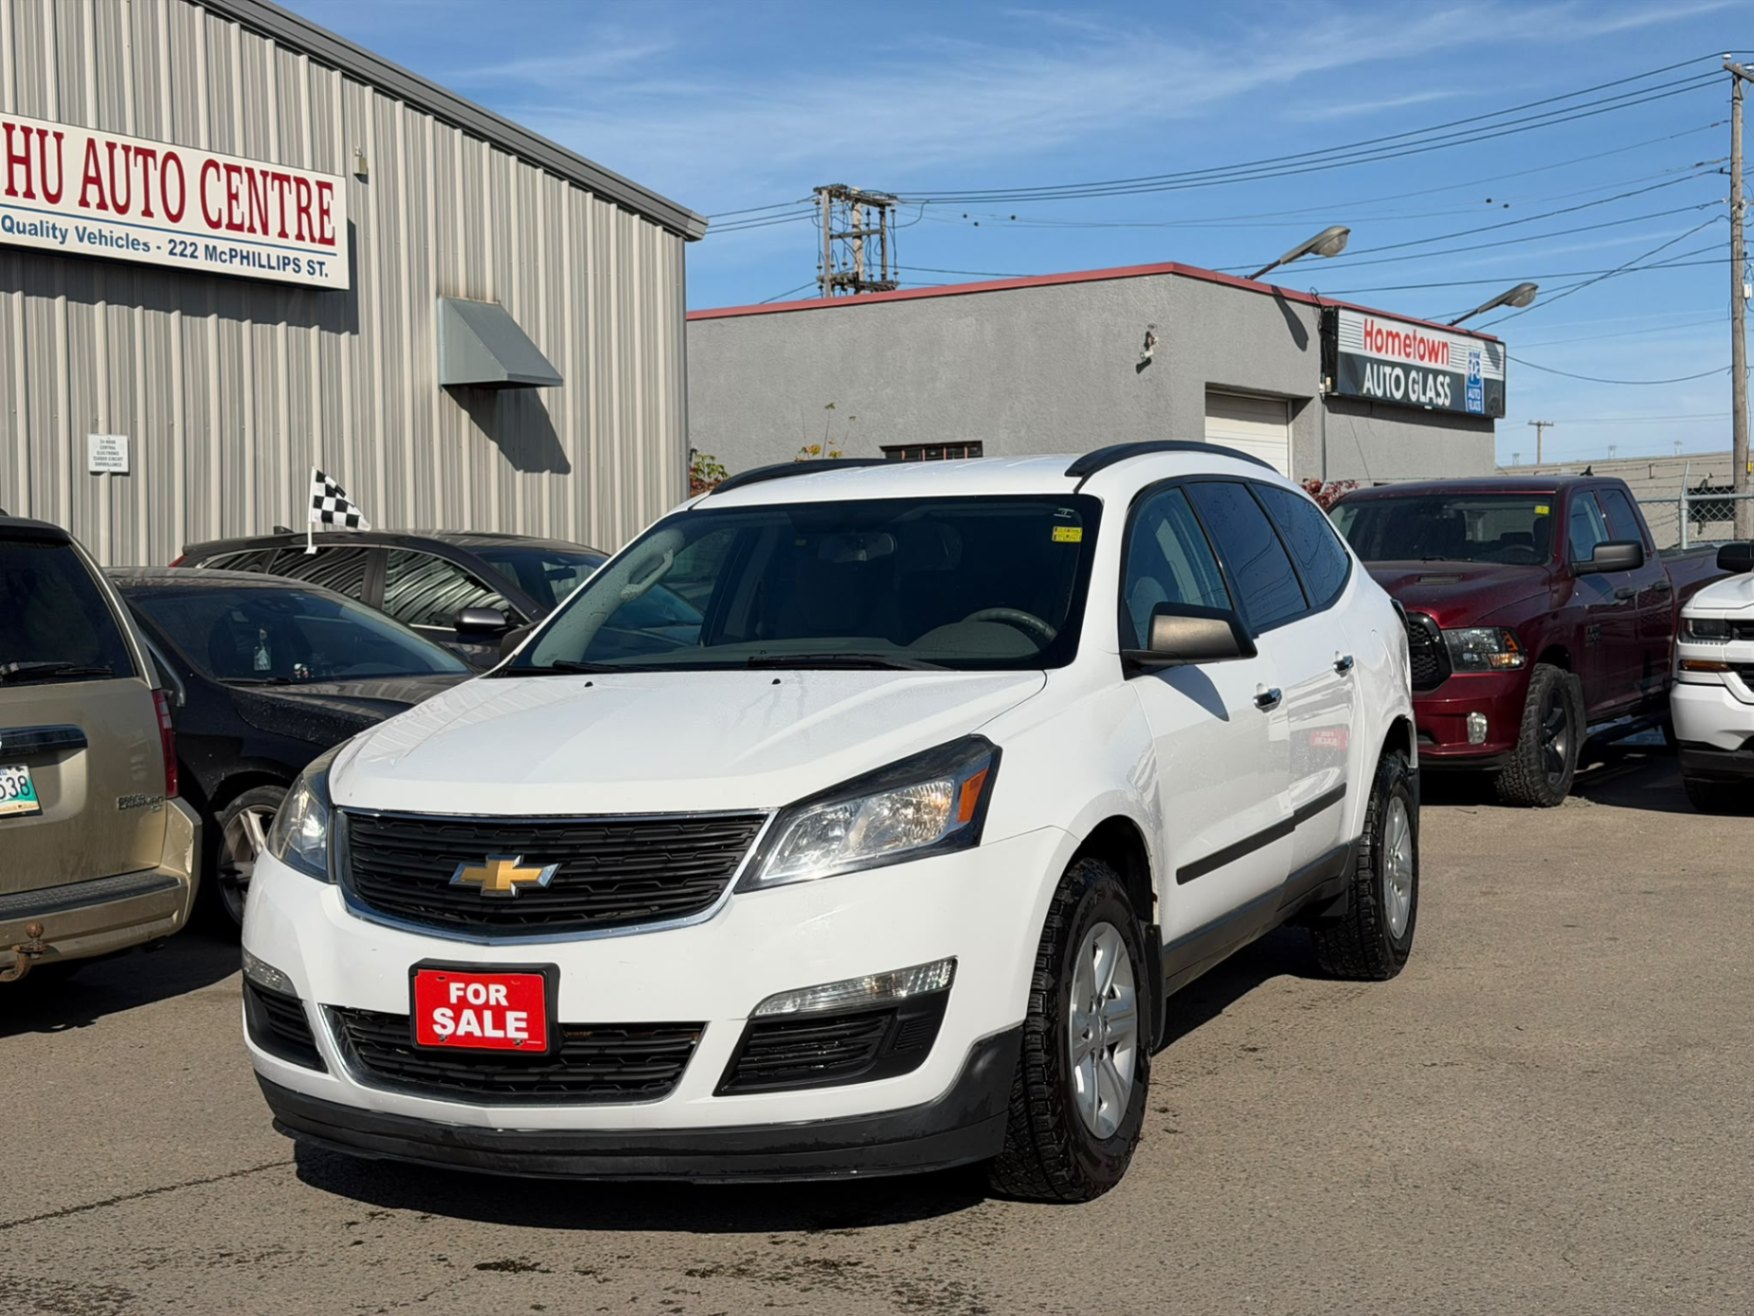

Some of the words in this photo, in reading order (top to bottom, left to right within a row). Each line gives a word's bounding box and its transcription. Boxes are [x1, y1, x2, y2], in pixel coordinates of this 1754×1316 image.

[2, 122, 65, 205] HU
[78, 137, 186, 224] AUTO
[199, 158, 336, 247] CENTRE
[1, 214, 69, 245] Quality
[75, 225, 150, 251] Vehicles
[168, 239, 199, 260] 222
[204, 243, 302, 274] McPHILLIPS
[306, 259, 329, 278] ST.
[1363, 318, 1450, 366] Hometown
[1362, 362, 1406, 400] AUTO
[1408, 369, 1451, 407] GLASS
[449, 982, 509, 1006] FOR
[432, 1007, 529, 1039] SALE
